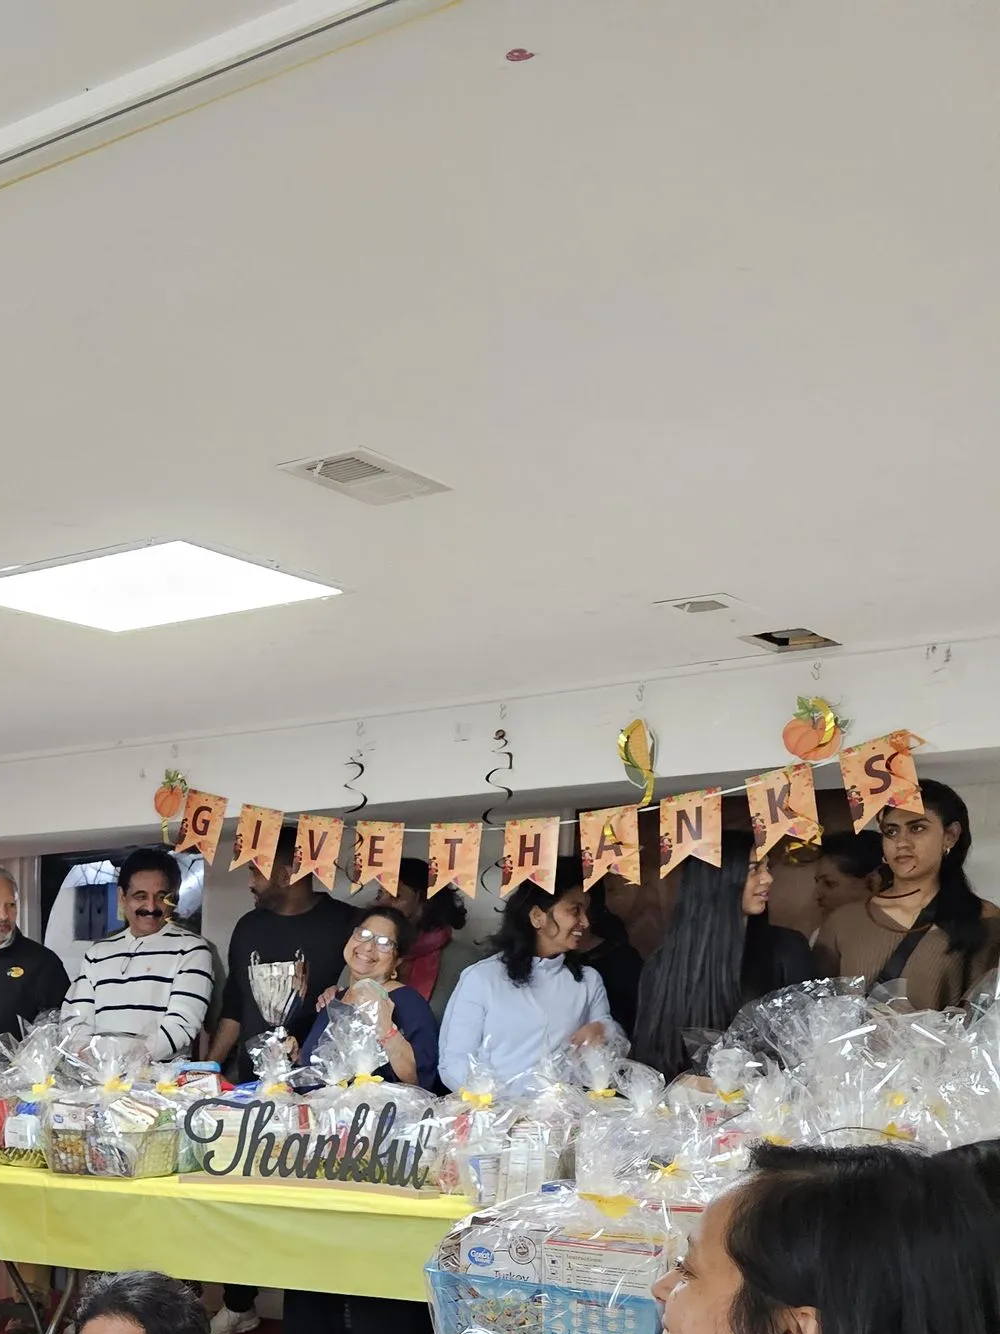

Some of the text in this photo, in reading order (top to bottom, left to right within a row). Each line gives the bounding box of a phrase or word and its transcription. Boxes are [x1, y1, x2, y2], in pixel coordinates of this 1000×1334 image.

[191, 753, 893, 871] GIVE THANKS
[184, 1098, 435, 1190] Thankful
